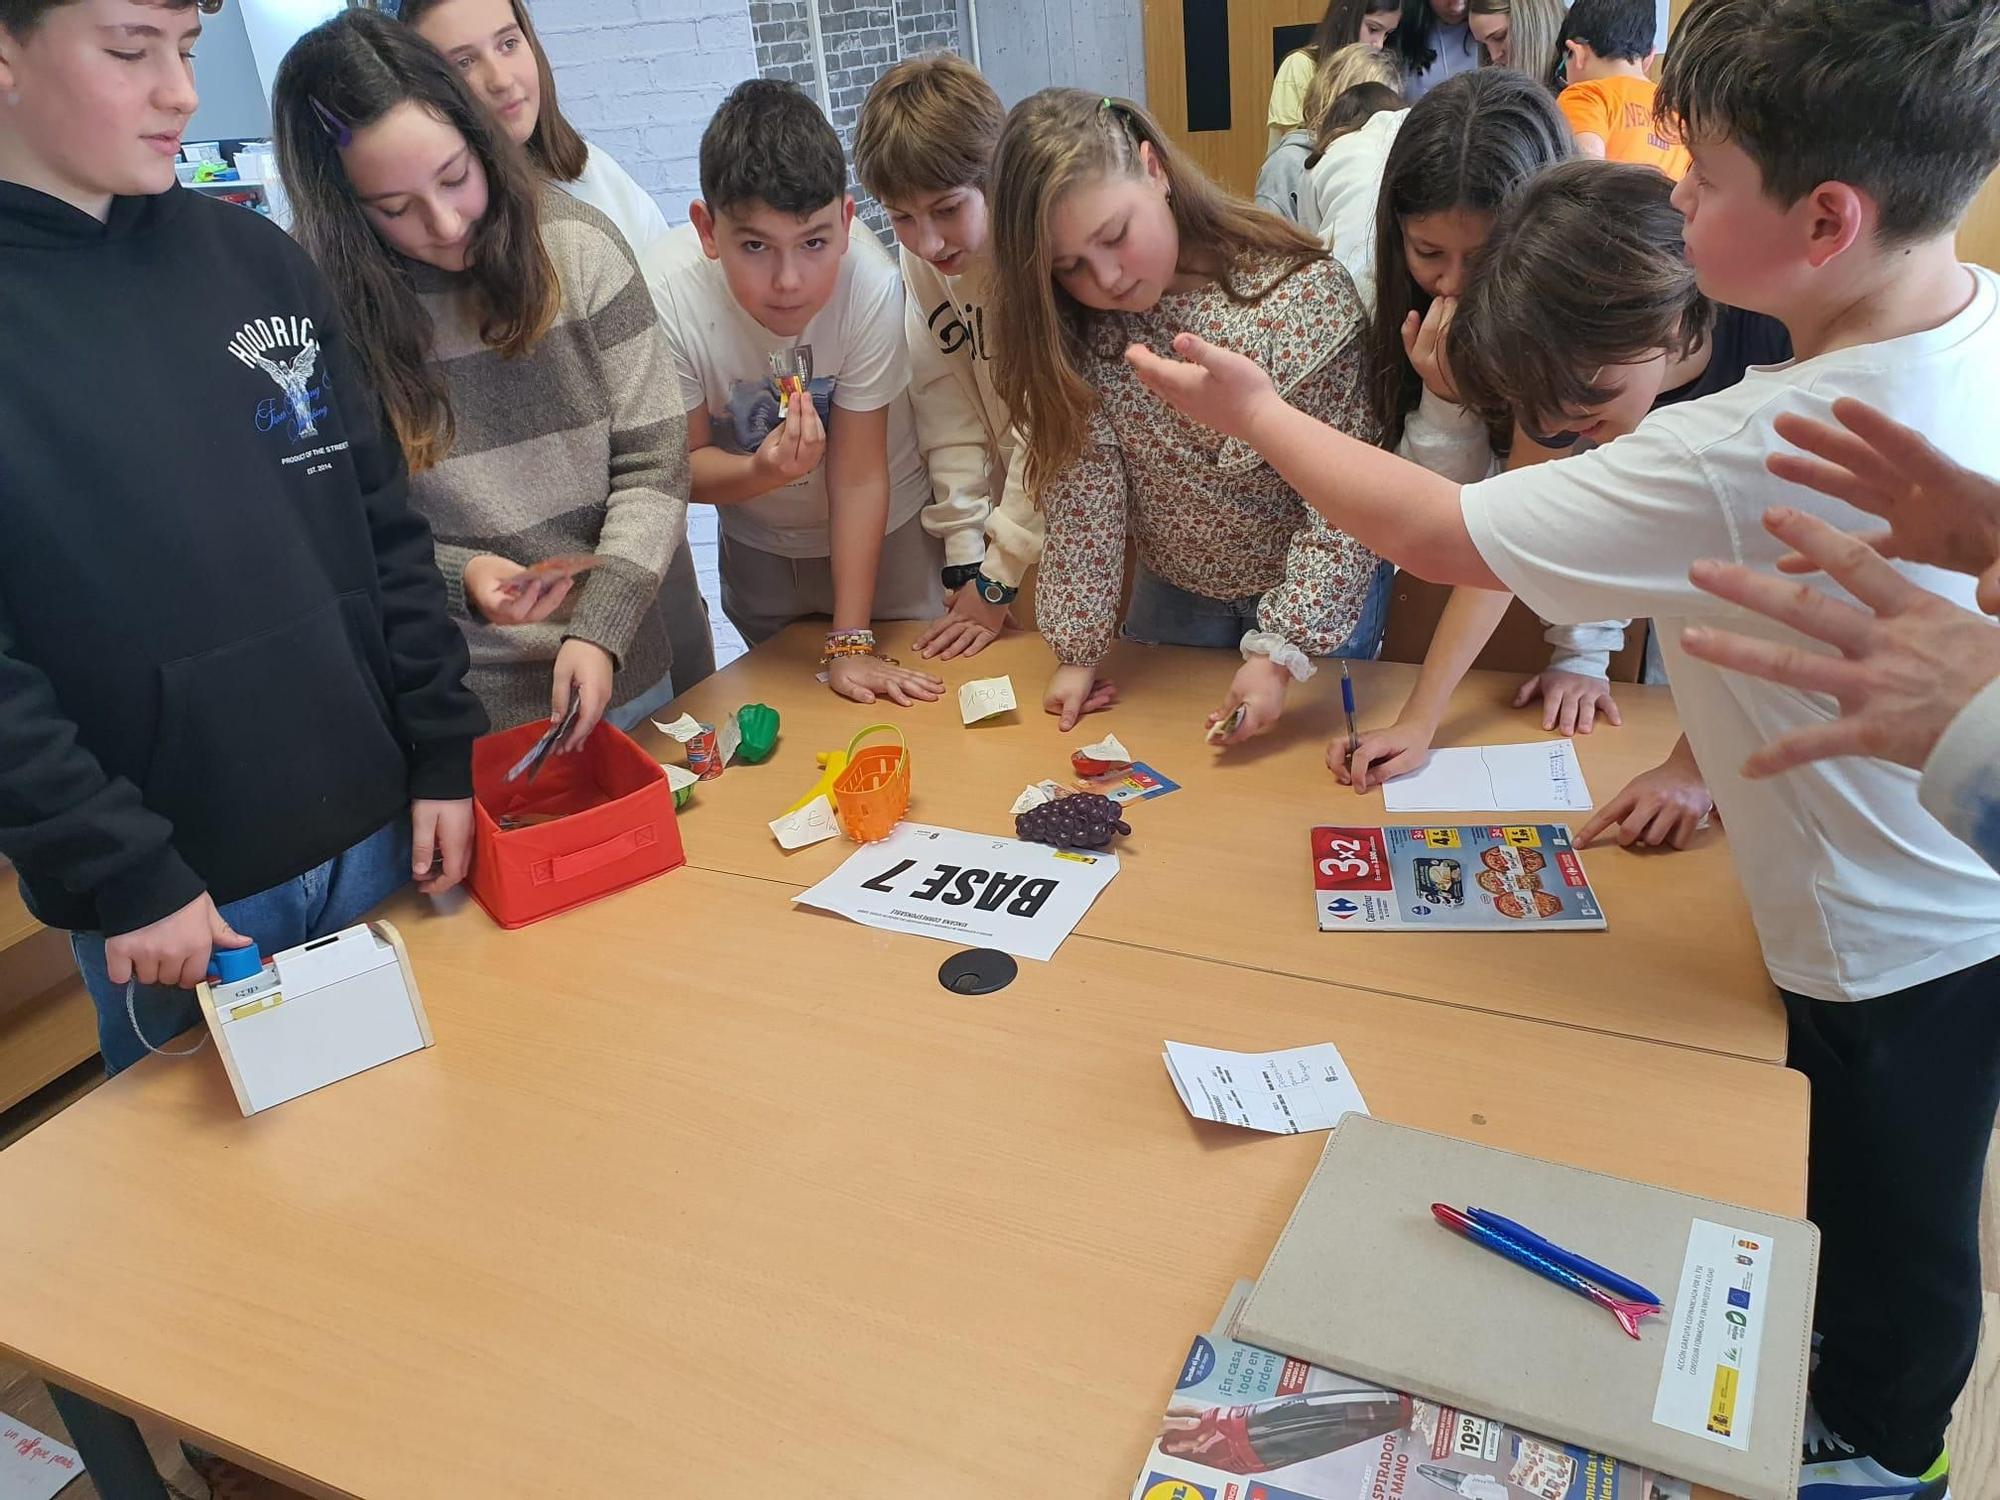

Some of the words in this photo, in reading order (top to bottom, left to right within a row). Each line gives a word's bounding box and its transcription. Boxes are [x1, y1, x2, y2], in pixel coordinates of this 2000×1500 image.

[227, 316, 321, 369] HOODRIC
[281, 451, 305, 466] PRODUCT
[304, 449, 313, 459] OF
[312, 446, 325, 457] THE
[860, 859, 918, 893] 7
[909, 864, 1060, 918] BASE
[1362, 895, 1376, 922] Carrefour
[1219, 1375, 1232, 1396] ¡En
[1228, 1349, 1246, 1375] casa,
[1236, 1368, 1254, 1394] todo
[1248, 1351, 1260, 1366] en
[1257, 1354, 1277, 1392] orden!
[1391, 1454, 1409, 1493] MANO
